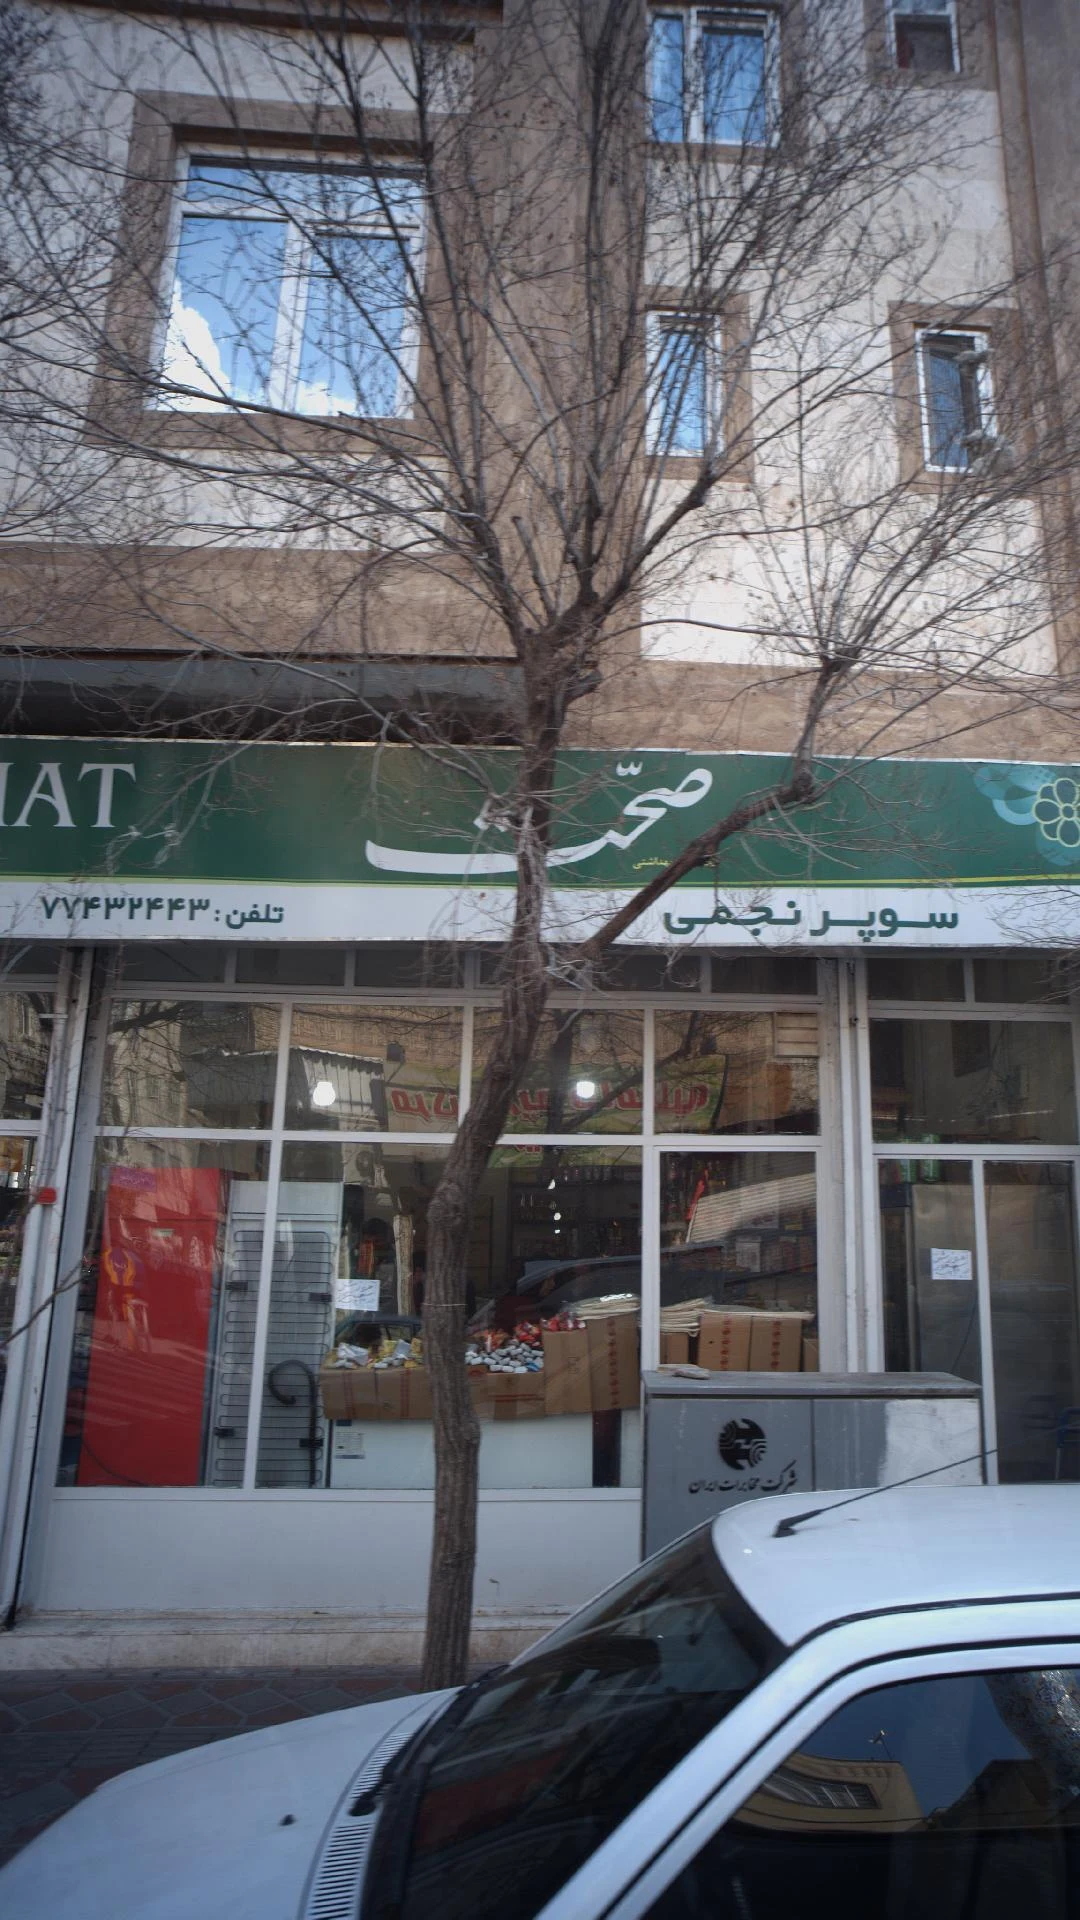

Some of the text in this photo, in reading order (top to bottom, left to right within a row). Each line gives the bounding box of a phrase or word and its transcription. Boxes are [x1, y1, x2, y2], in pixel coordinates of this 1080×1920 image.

[664, 900, 959, 943] سوپر نجمی
[688, 1479, 718, 1494] ایران
[760, 1459, 798, 1494] شرکت
